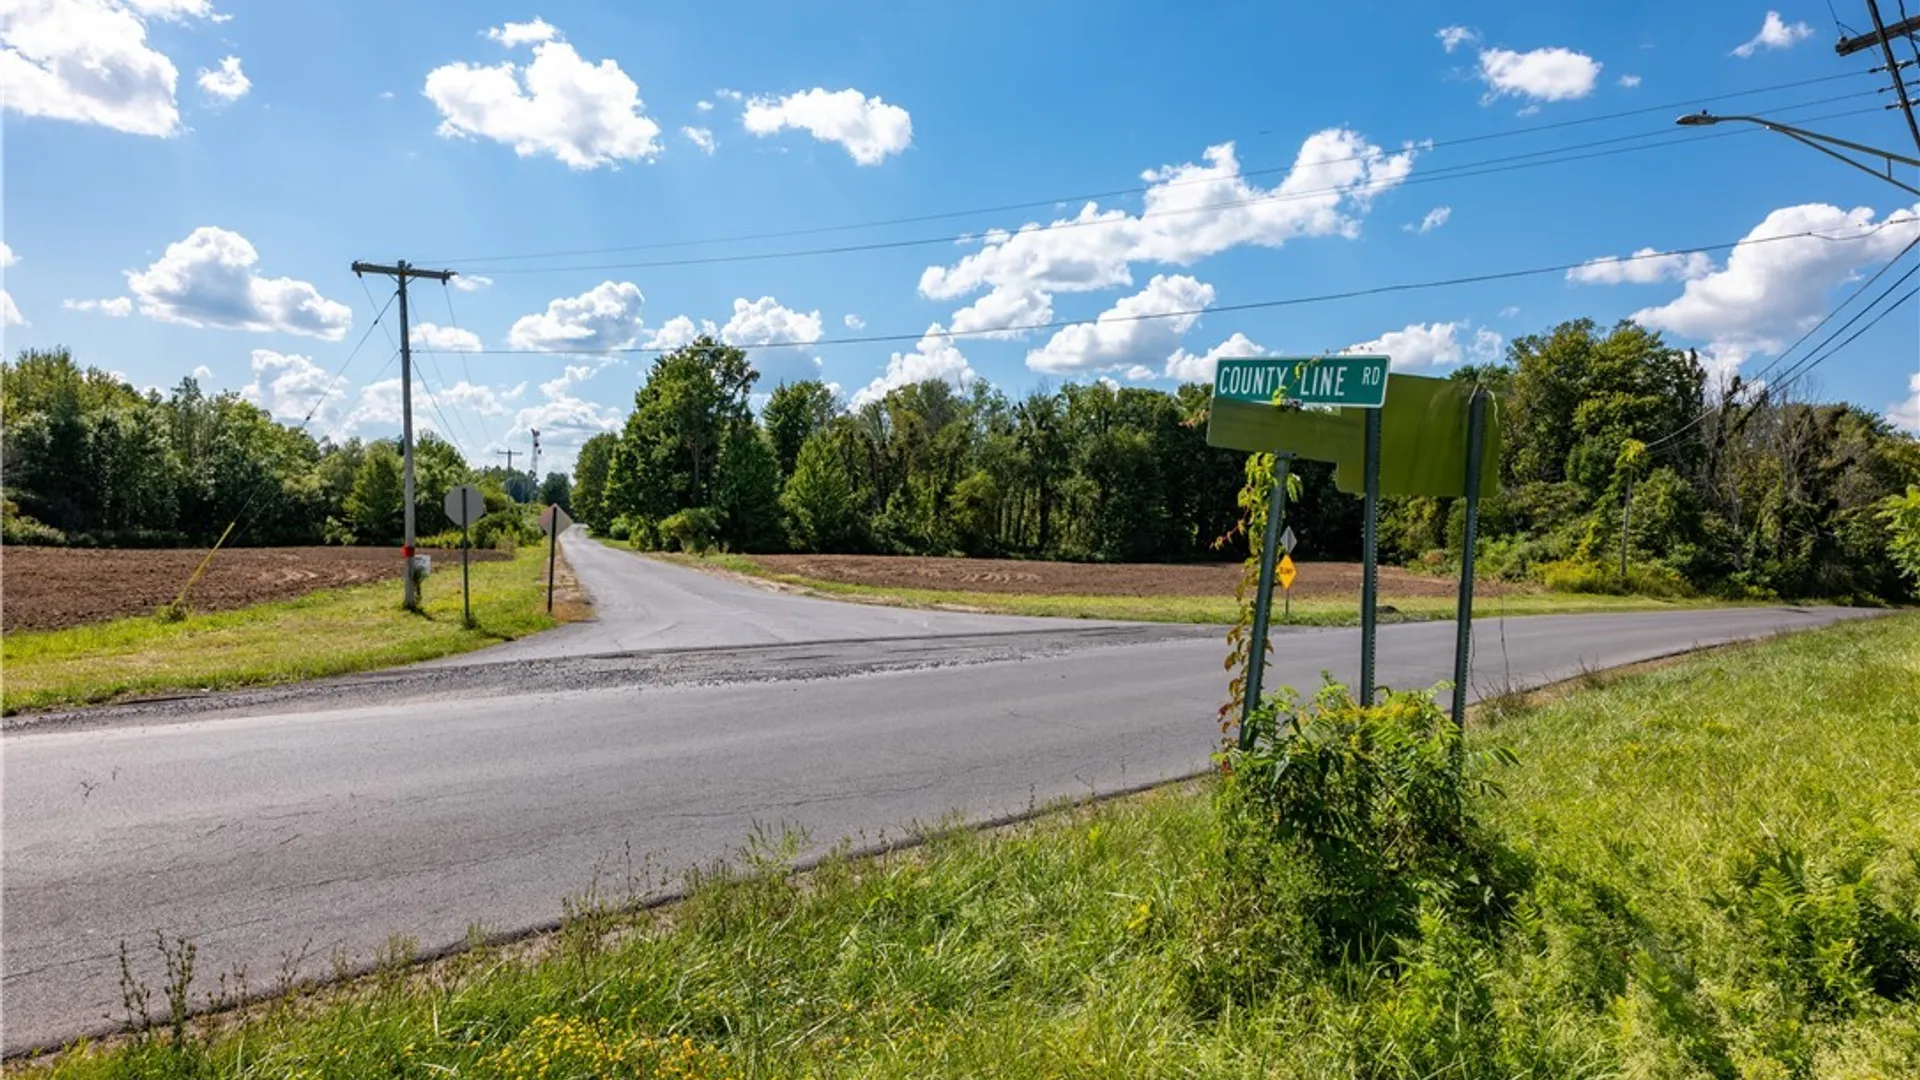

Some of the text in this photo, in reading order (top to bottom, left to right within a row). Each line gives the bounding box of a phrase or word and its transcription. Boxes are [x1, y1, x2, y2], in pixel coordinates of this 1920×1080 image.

[1219, 366, 1381, 396] COUNTY LINE RD
